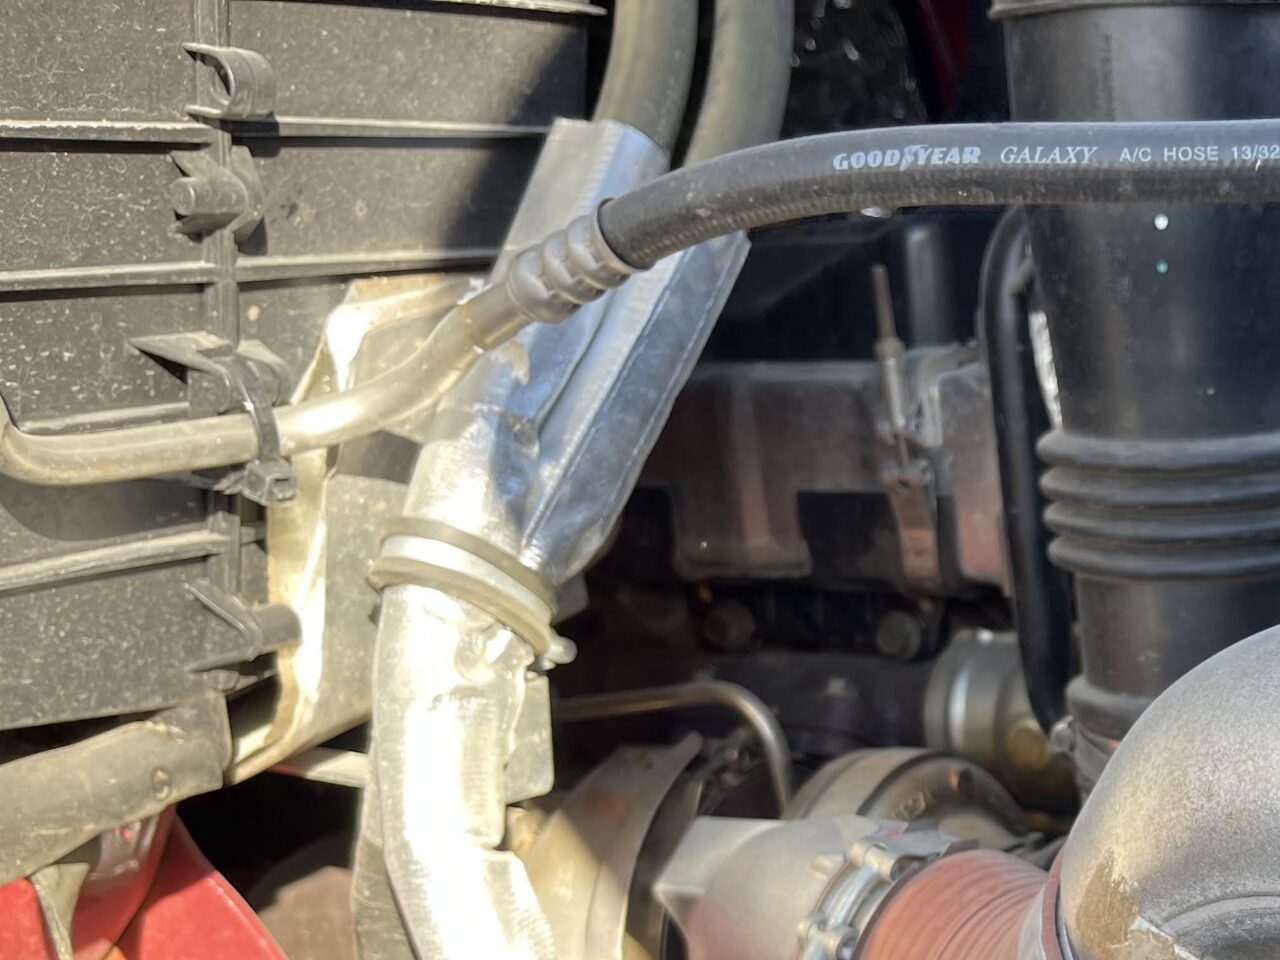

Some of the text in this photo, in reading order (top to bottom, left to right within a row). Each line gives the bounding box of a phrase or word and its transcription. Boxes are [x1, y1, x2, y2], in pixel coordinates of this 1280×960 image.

[832, 144, 981, 172] GOODYEAR
[1000, 146, 1098, 165] GALAXY
[1119, 147, 1152, 163] A/C
[1163, 145, 1219, 162] HOSE
[1231, 143, 1280, 160] 13/32
